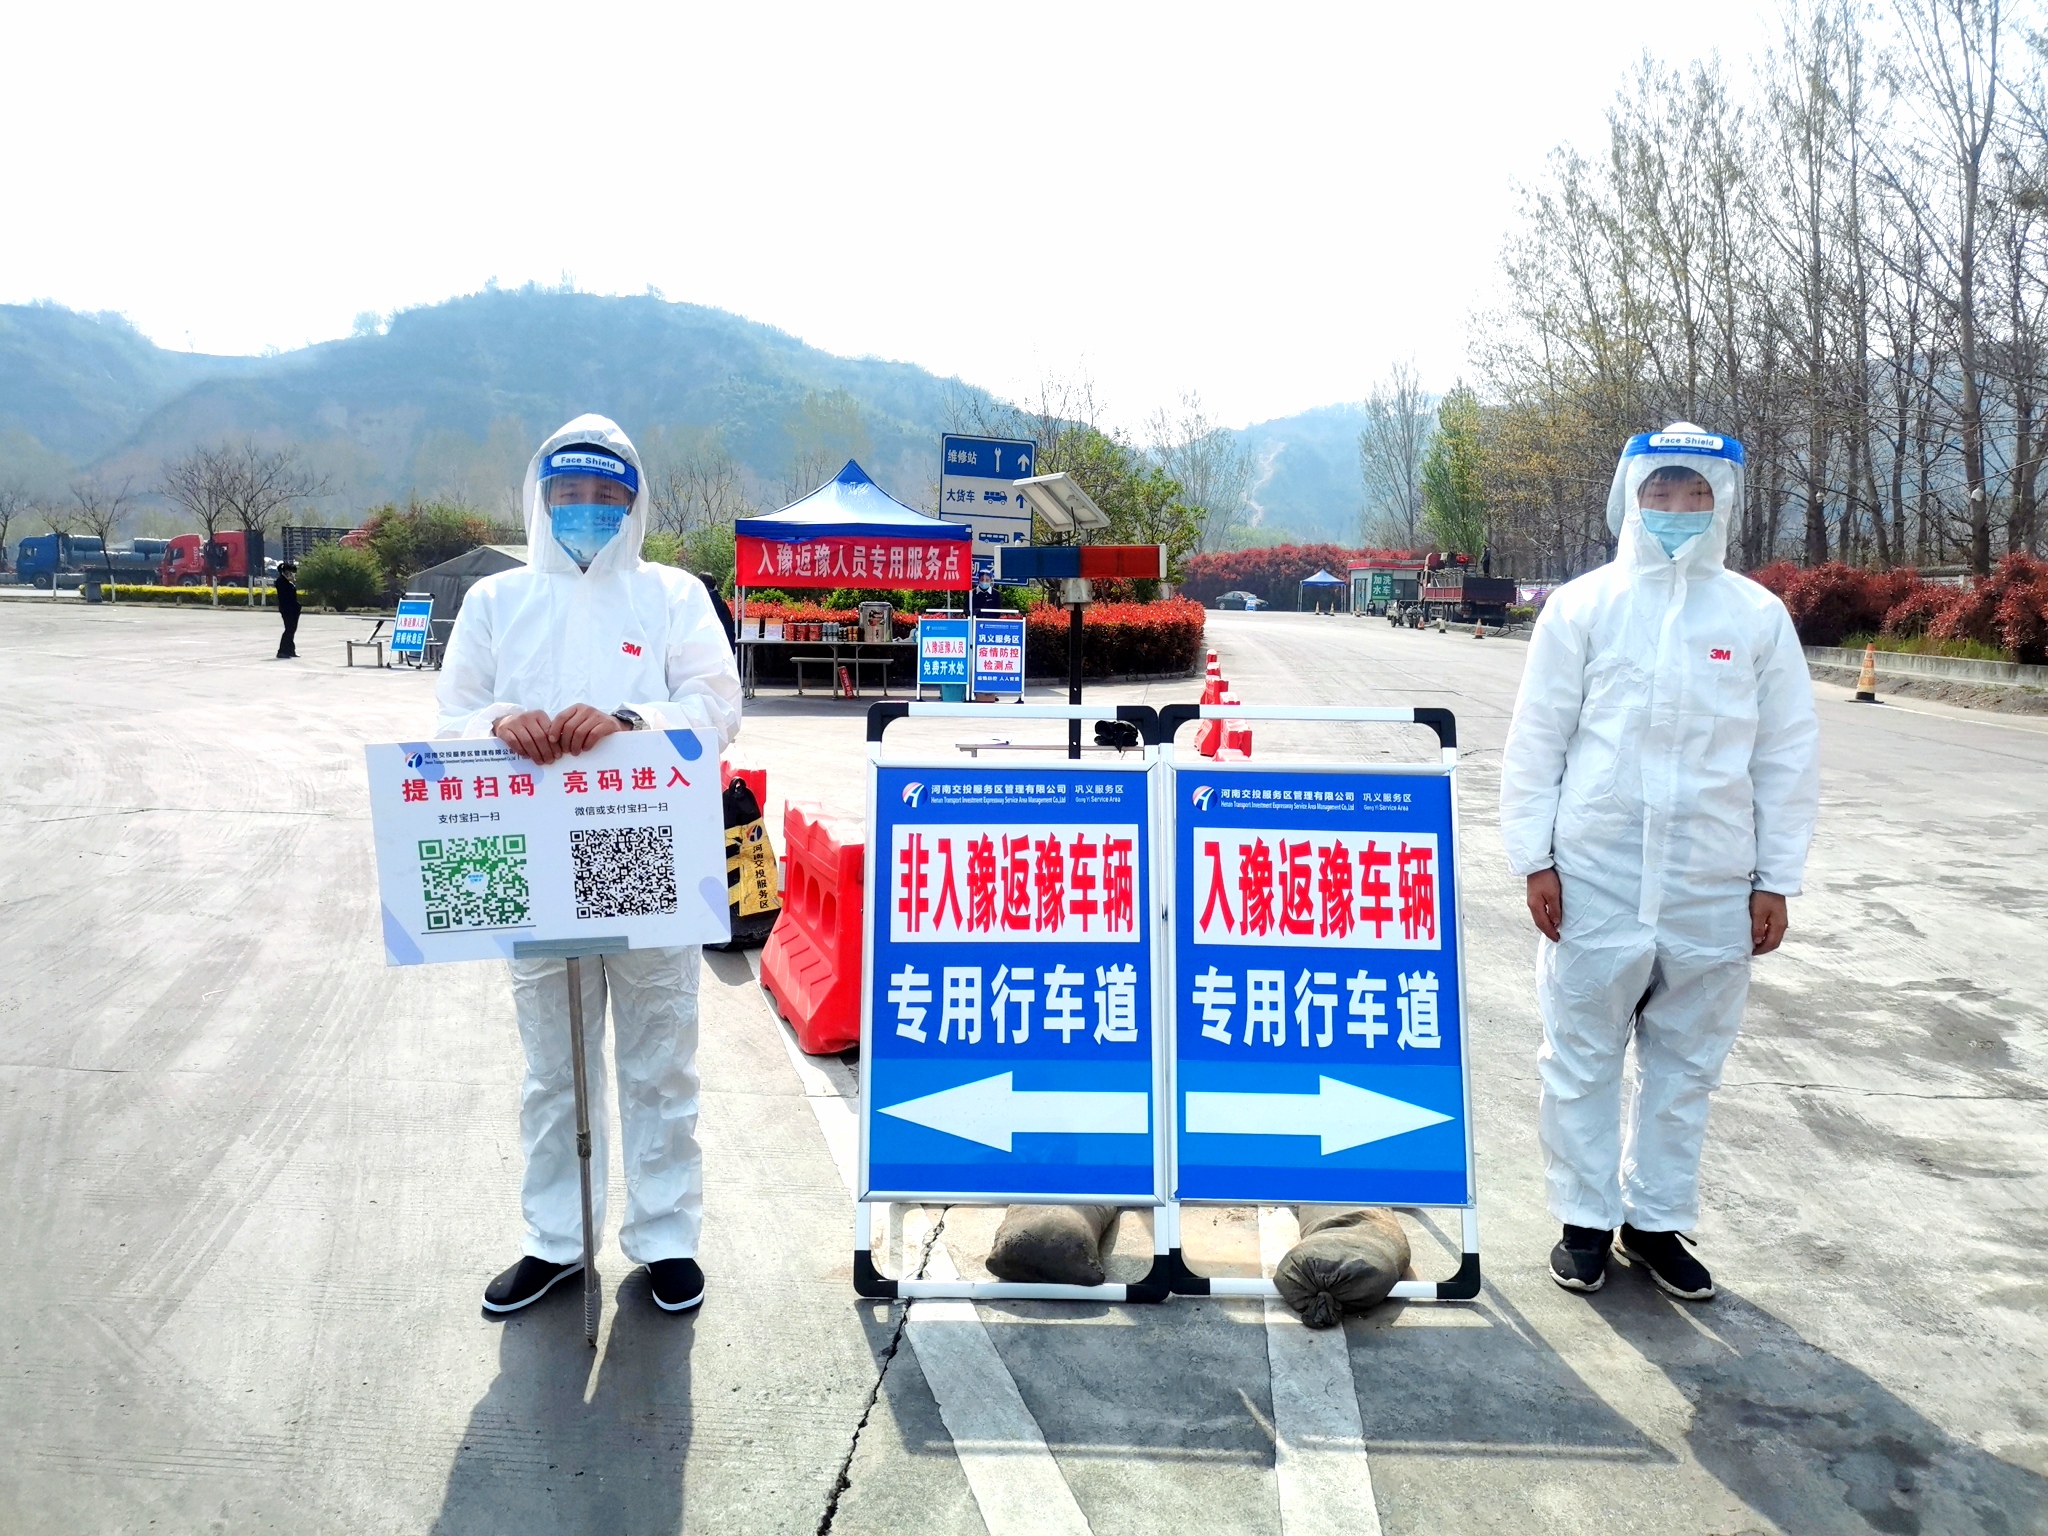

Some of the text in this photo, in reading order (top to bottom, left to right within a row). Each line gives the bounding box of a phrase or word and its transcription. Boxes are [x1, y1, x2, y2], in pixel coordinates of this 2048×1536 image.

[1685, 436, 1714, 447] Shield
[561, 456, 616, 470] Face Shield
[947, 449, 978, 466] 维修站
[946, 488, 976, 504] 大货车
[757, 543, 960, 580] 入豫返豫人员专用服务点
[978, 634, 1020, 644] 巩义服务区
[622, 641, 642, 656] 3M
[925, 641, 964, 654] 入豫返豫人员
[979, 647, 1019, 658] 疫情防控
[1710, 648, 1731, 660] 3M
[923, 660, 965, 676] 免费开水处
[984, 660, 1014, 671] 检测点
[402, 766, 692, 803] 提前扫码 亮码进入
[931, 784, 1124, 795] 河南交投服务区管理有限公司 巩义服务区
[1221, 788, 1412, 803] 河南交投服务区管理有限公司 巩义服务区
[574, 802, 669, 817] 微信或支付宝扫一扫
[438, 811, 501, 825] 支付宝扫一扫
[753, 843, 770, 910] 河南交投服务区
[898, 832, 1134, 934] 非入豫返豫车辆
[1199, 836, 1436, 942] 入豫返豫车辆
[887, 963, 1140, 1046] 专用行车道
[1191, 965, 1442, 1051] 专用行车道
